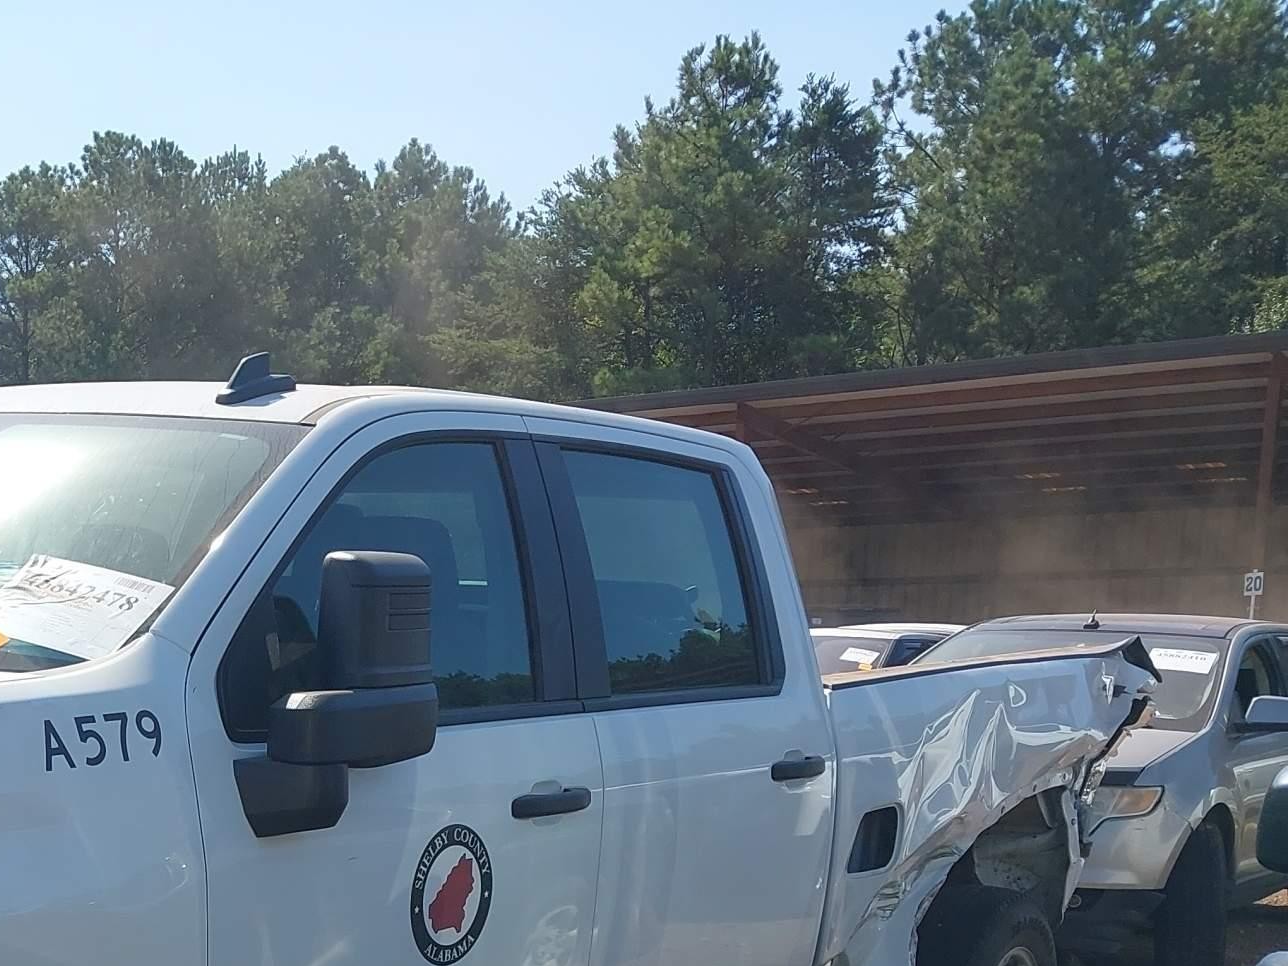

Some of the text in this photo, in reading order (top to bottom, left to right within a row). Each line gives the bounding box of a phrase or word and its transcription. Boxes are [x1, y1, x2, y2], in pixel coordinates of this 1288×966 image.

[1246, 575, 1262, 592] 20
[43, 709, 162, 772] A579
[415, 828, 490, 890] SHELBY COUNTY
[424, 934, 475, 962] ALABAMA
